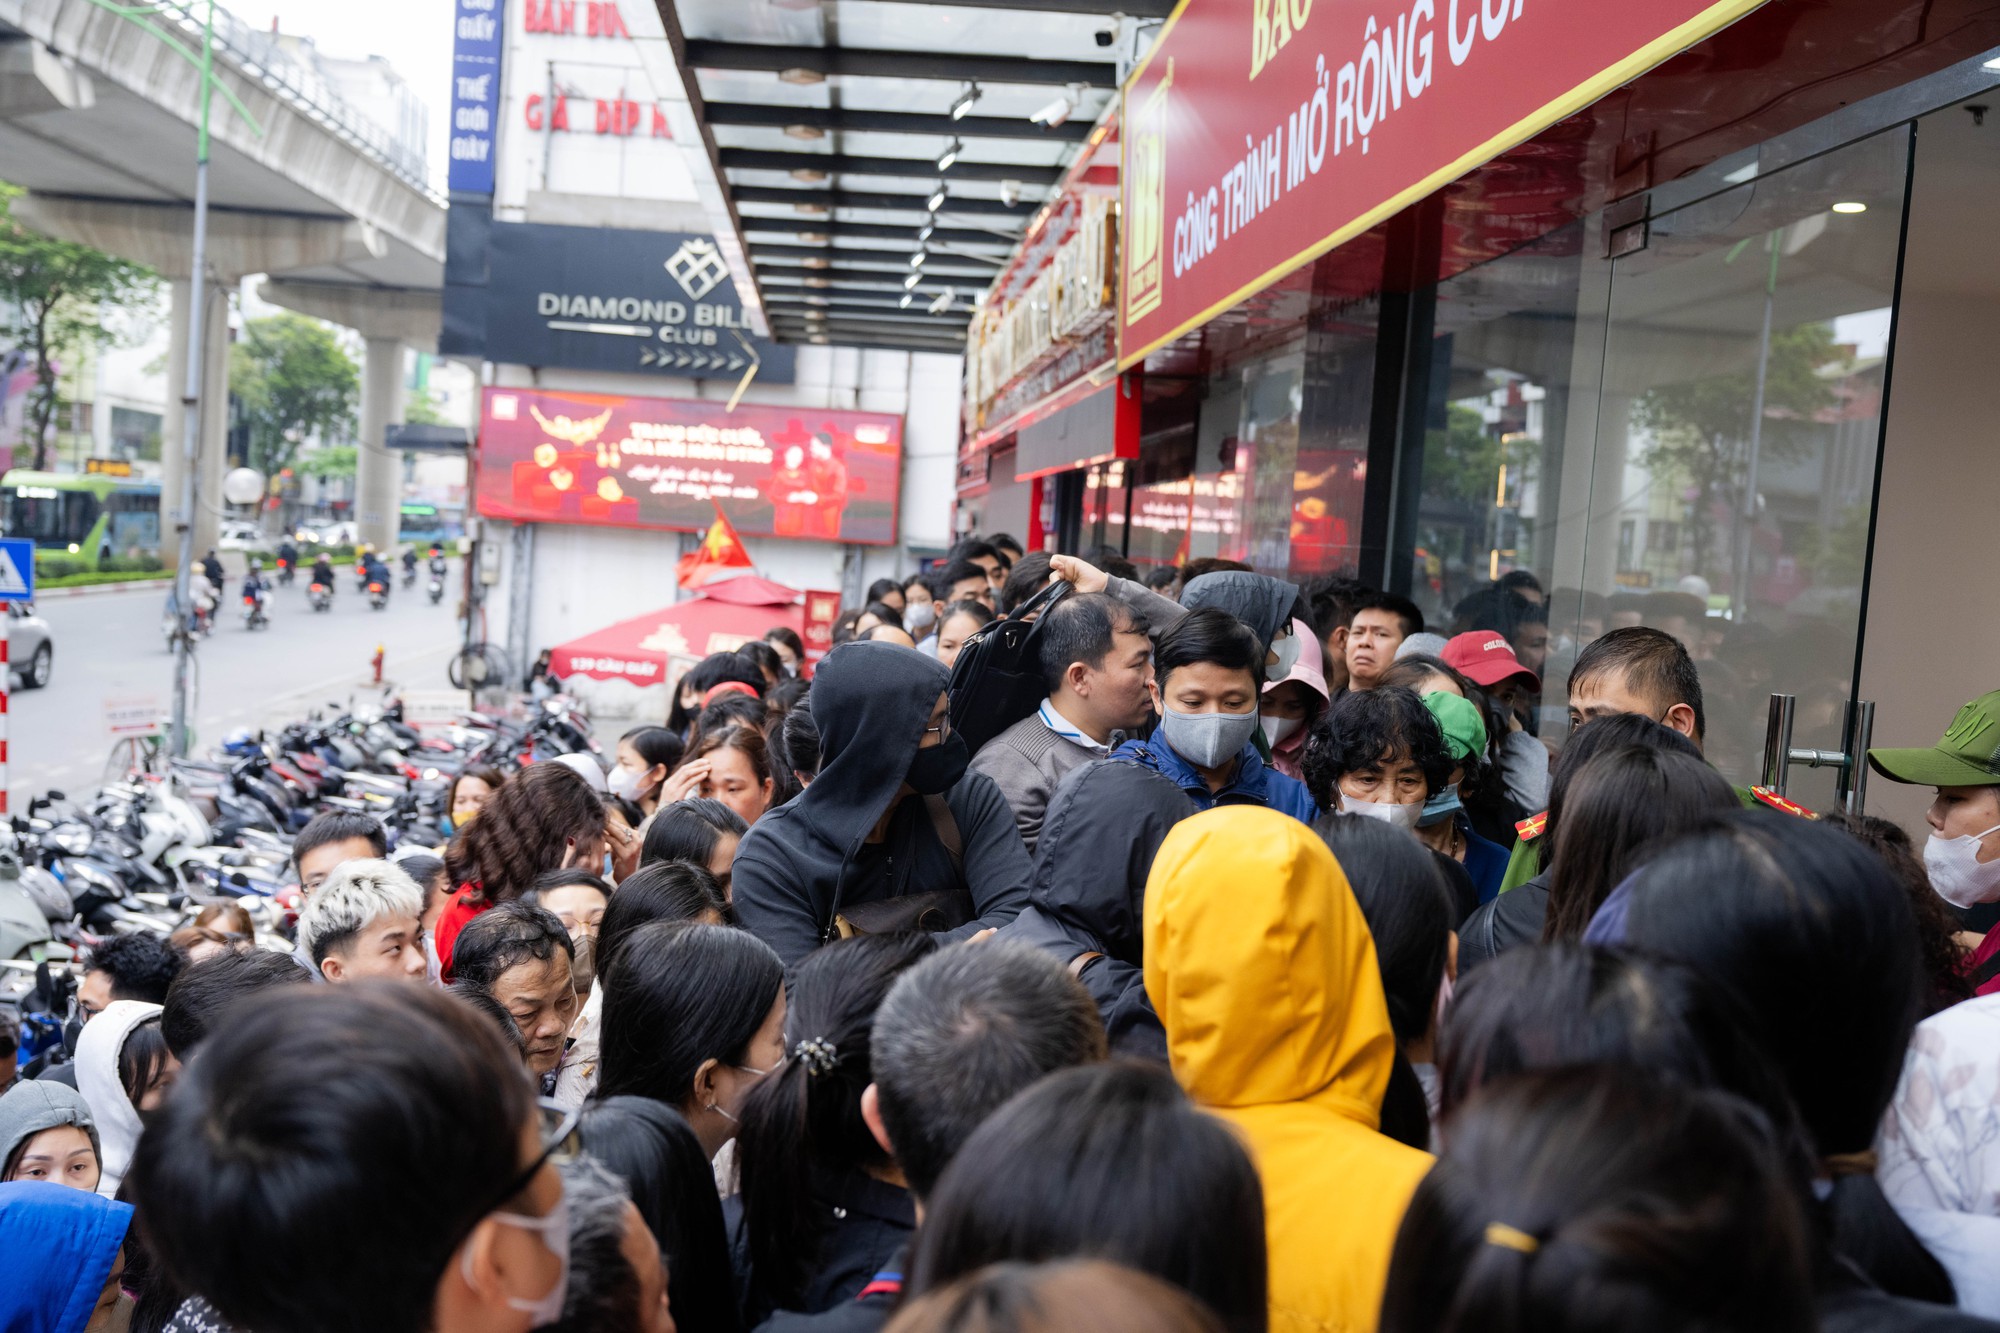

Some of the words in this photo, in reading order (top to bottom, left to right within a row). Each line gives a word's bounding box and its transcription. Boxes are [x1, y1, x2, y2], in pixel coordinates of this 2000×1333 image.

[456, 73, 492, 102] THẾ
[1173, 185, 1218, 278] CÔNG
[1221, 133, 1282, 240] TRÌNH
[1286, 53, 1330, 192] MỞ
[1334, 0, 1435, 156] RỘNG
[537, 292, 687, 324] DIAMOND
[658, 325, 718, 346] CLUB
